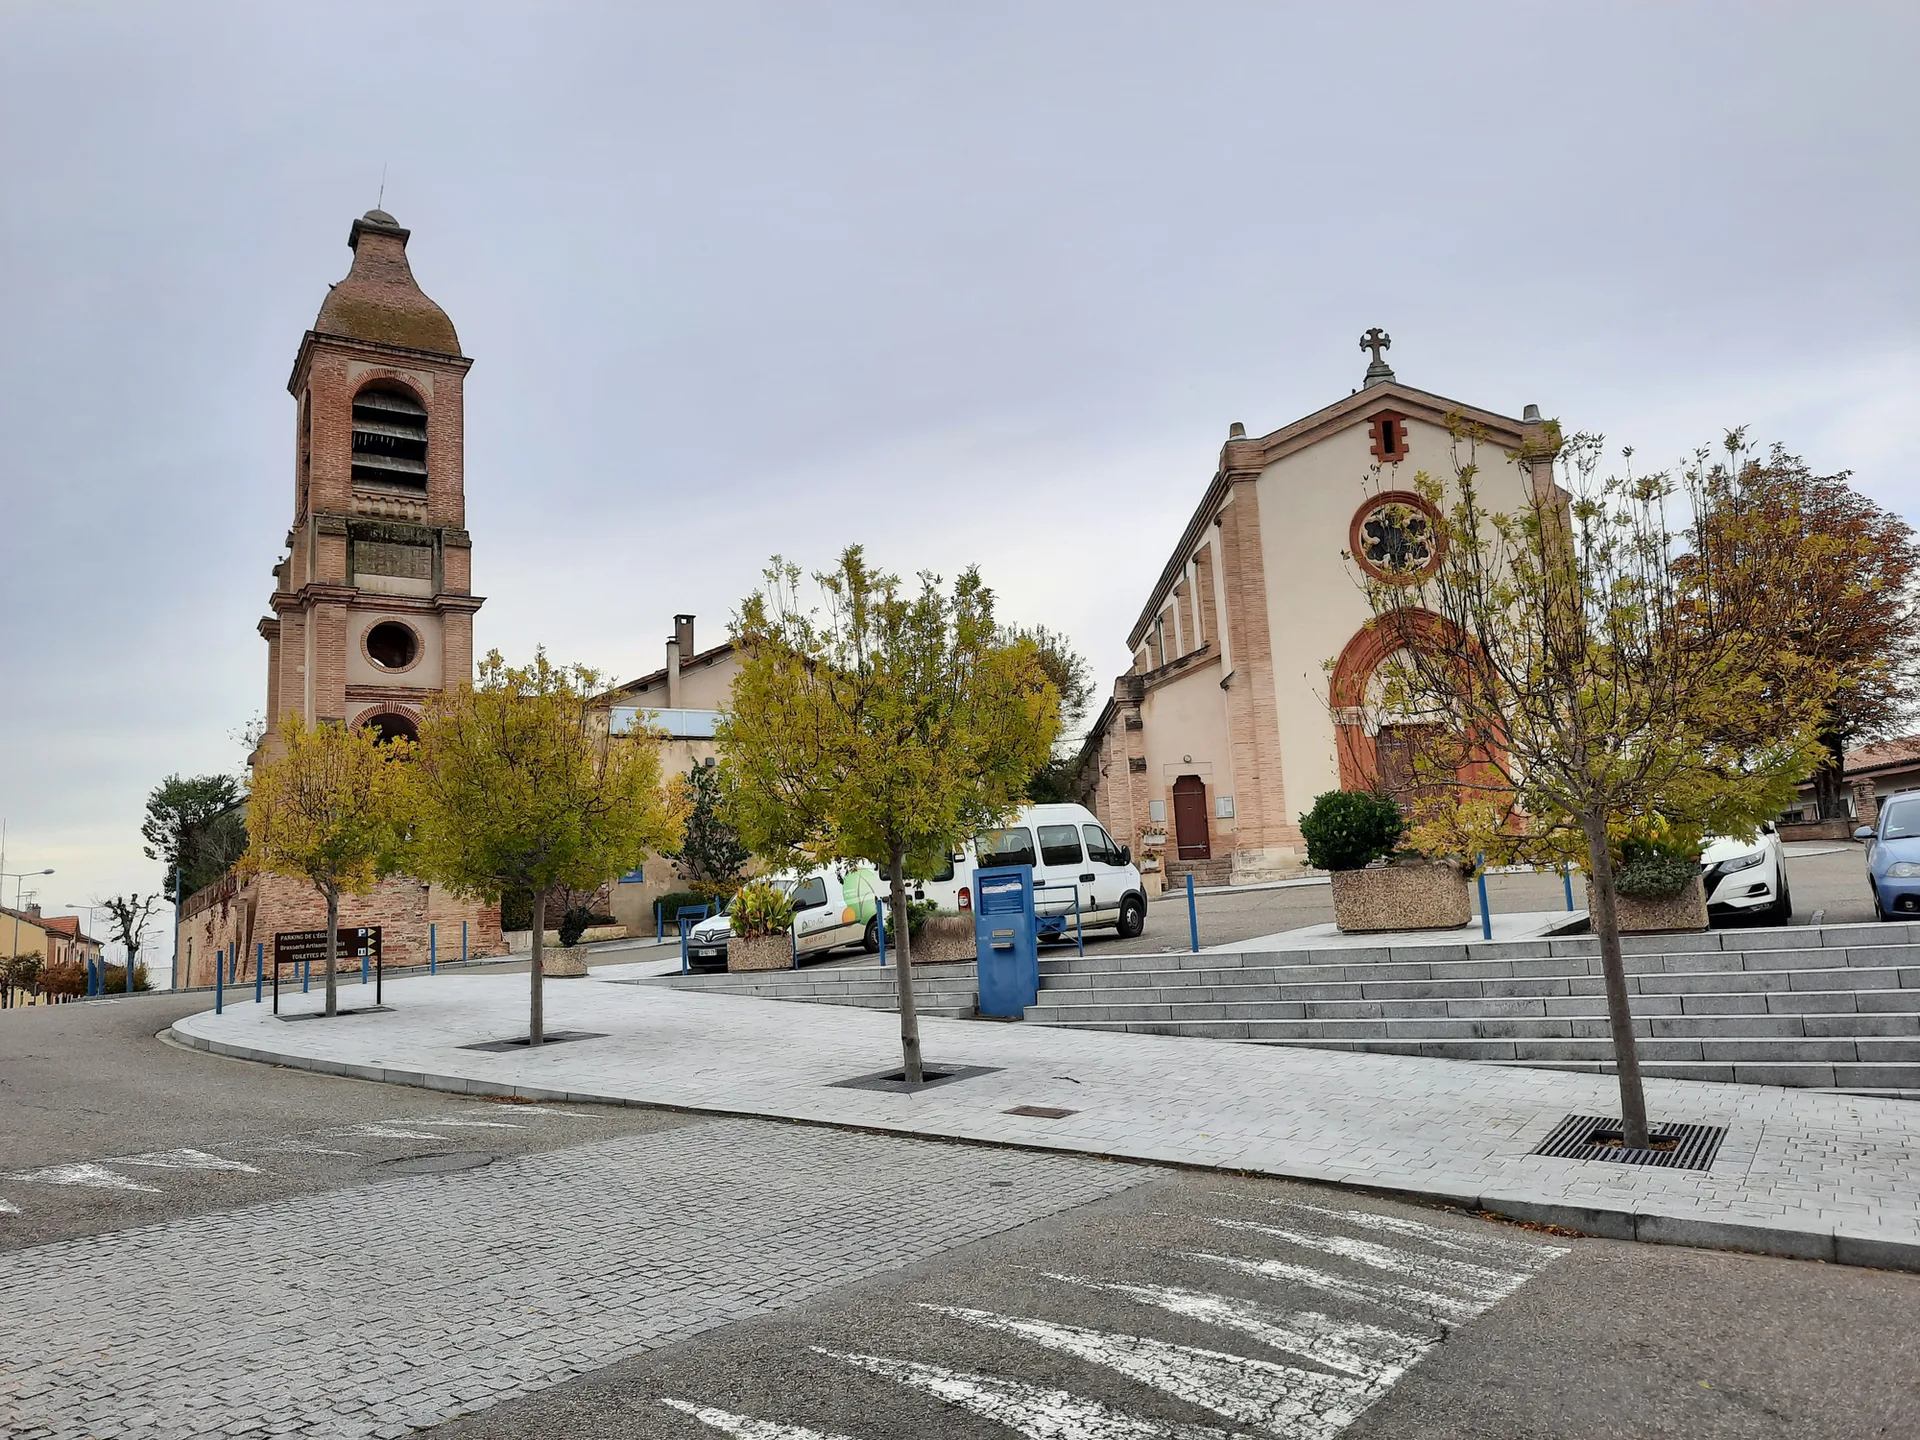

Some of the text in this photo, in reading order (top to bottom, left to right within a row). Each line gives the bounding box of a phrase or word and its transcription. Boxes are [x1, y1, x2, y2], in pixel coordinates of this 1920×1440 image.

[280, 933, 304, 942] PARKING
[304, 932, 312, 940] DE
[358, 929, 366, 937] P
[292, 952, 319, 960] TOILETTES
